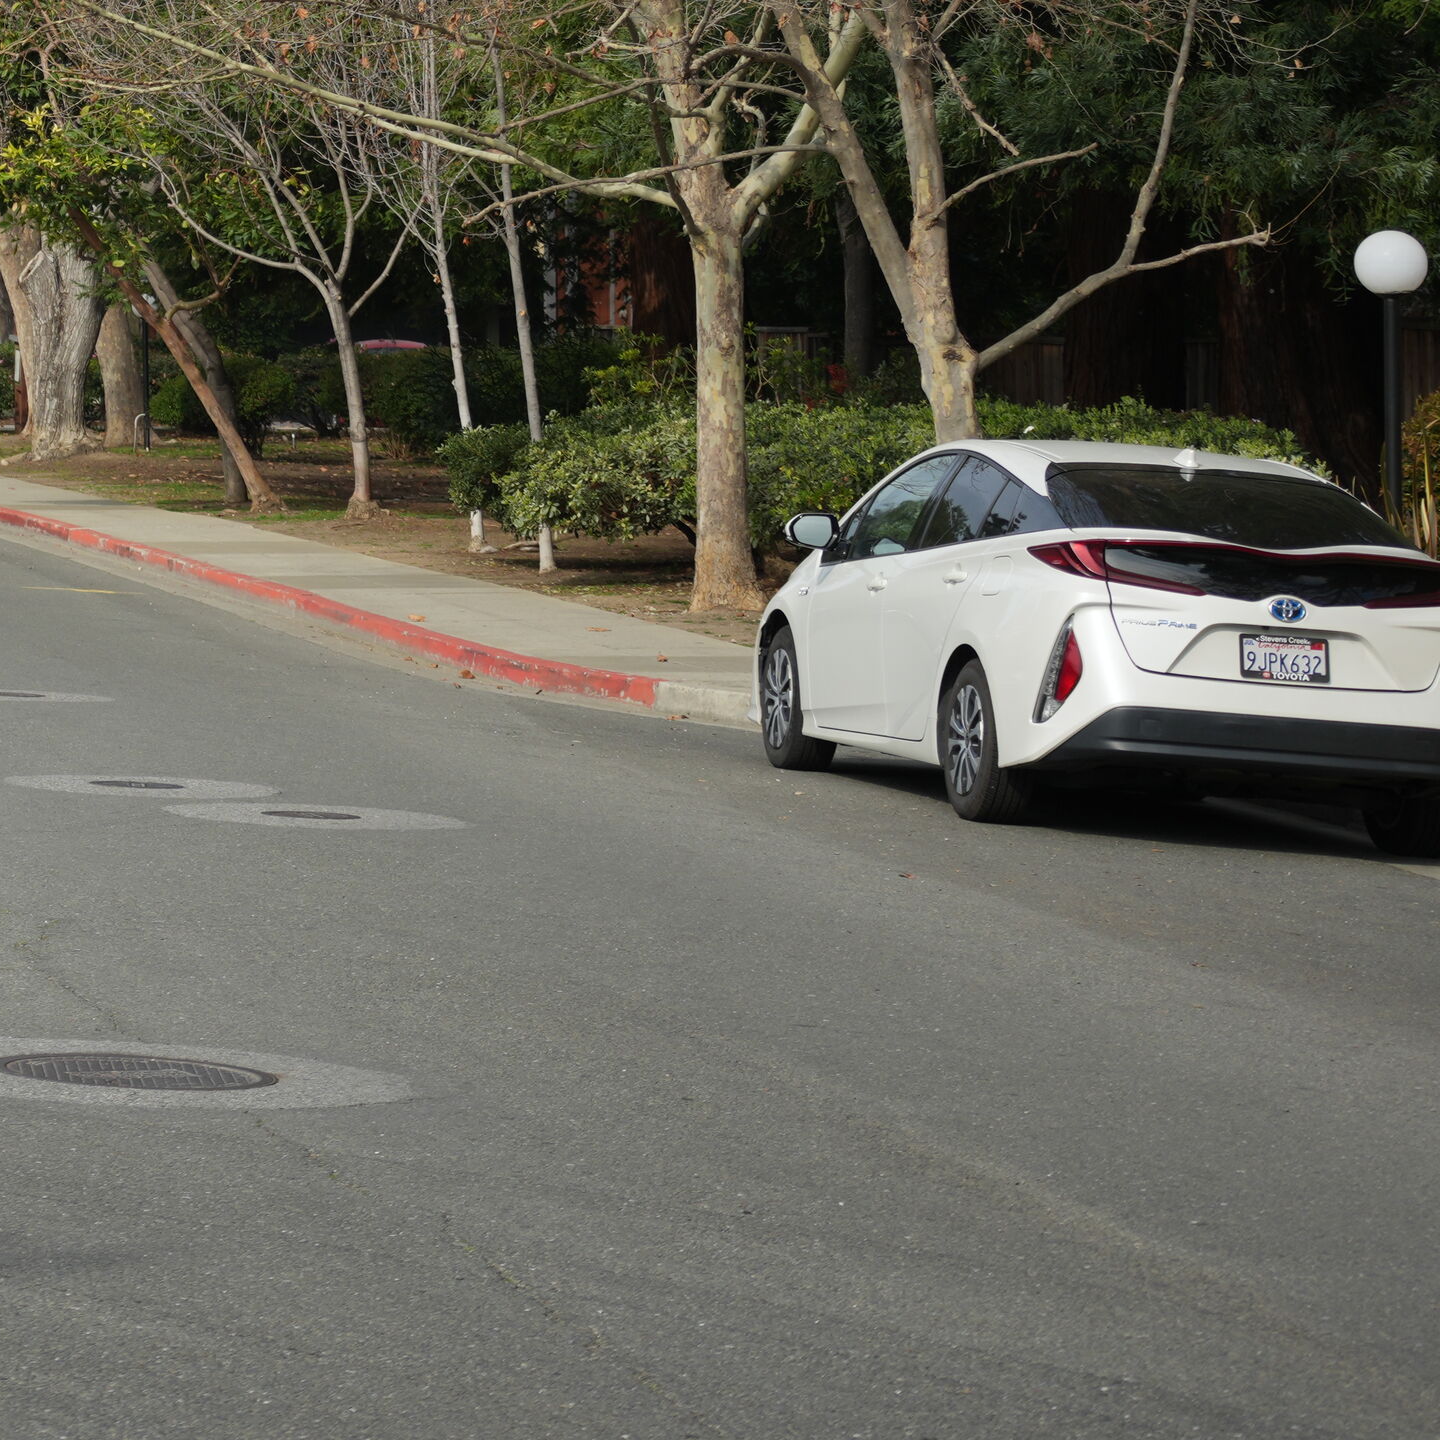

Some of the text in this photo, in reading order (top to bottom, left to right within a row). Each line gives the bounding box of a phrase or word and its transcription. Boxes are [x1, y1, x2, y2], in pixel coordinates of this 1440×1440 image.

[1157, 619, 1197, 629] PRIME
[1260, 635, 1287, 643] Stevens
[1288, 636, 1308, 644] Creek
[1257, 641, 1306, 652] California
[1247, 651, 1322, 675] 9JPK632
[1272, 671, 1310, 681] TOYOTA
